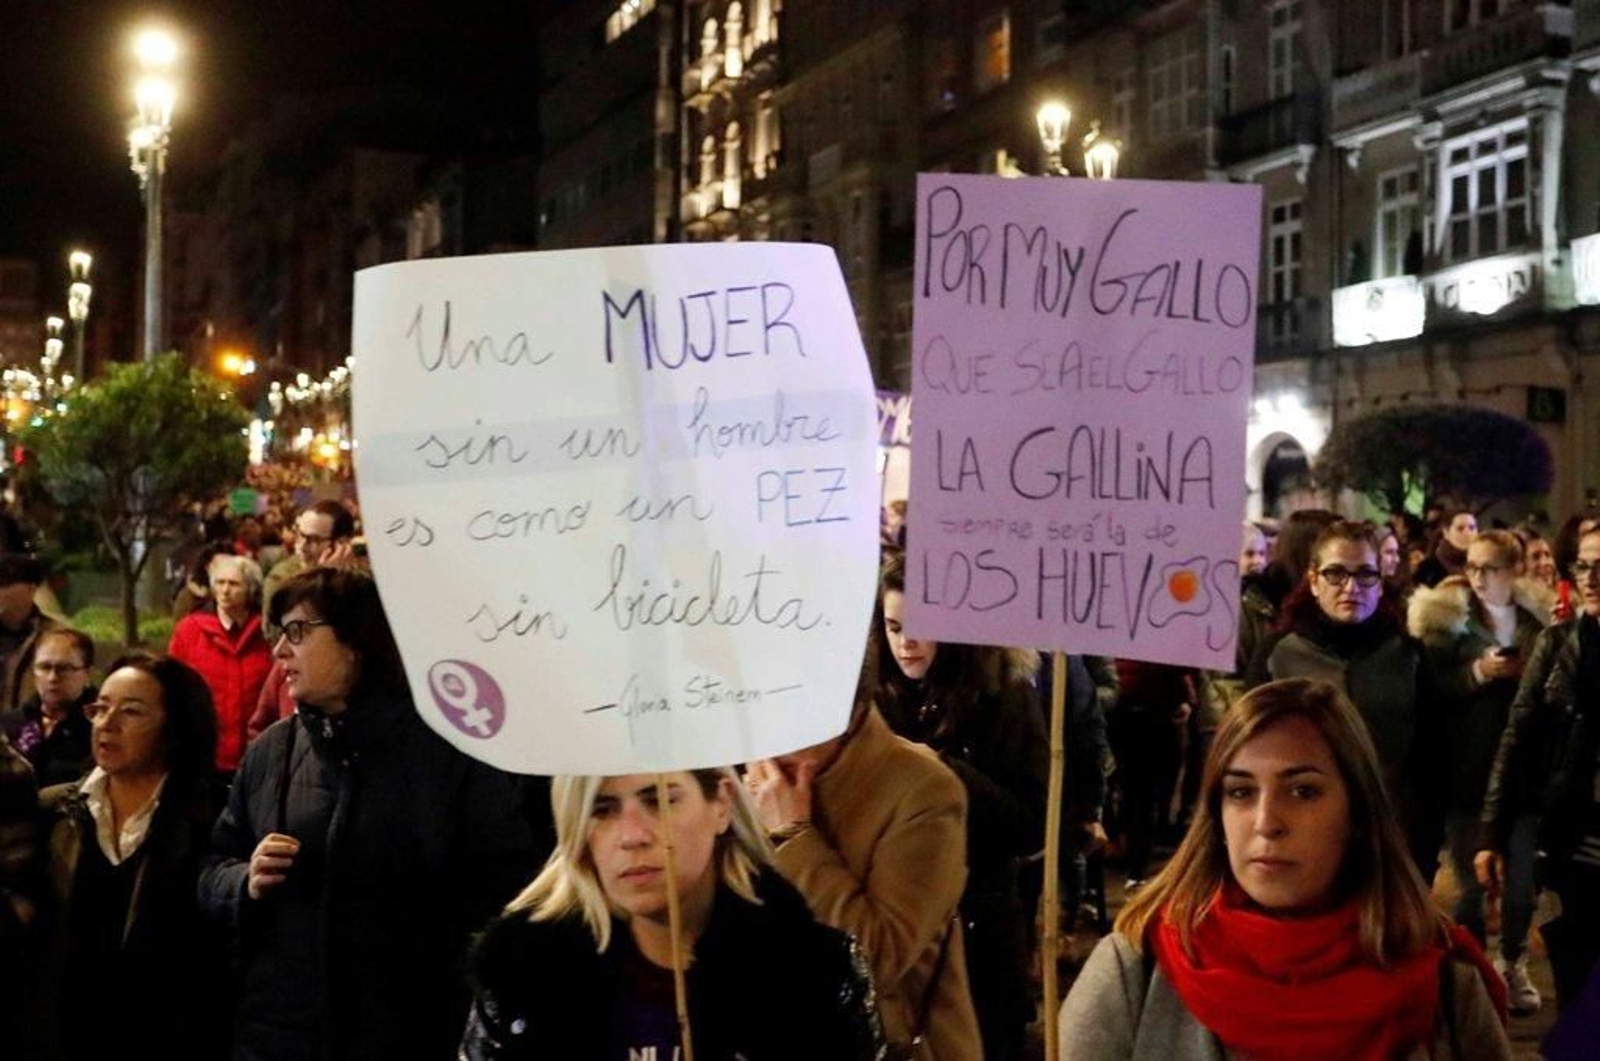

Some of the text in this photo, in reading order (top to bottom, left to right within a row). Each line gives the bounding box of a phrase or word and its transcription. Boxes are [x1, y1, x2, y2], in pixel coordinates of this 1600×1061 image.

[1090, 208, 1252, 328] GALLO
[406, 282, 806, 372] Una MUJER
[922, 335, 995, 395] QUE
[416, 420, 527, 468] sin
[559, 427, 641, 462] un
[690, 387, 842, 460] hombre
[937, 428, 985, 492] LA
[386, 468, 851, 547] es como un PEZ
[1145, 514, 1178, 548] de
[923, 549, 1018, 611] LOS
[467, 594, 568, 642] sin
